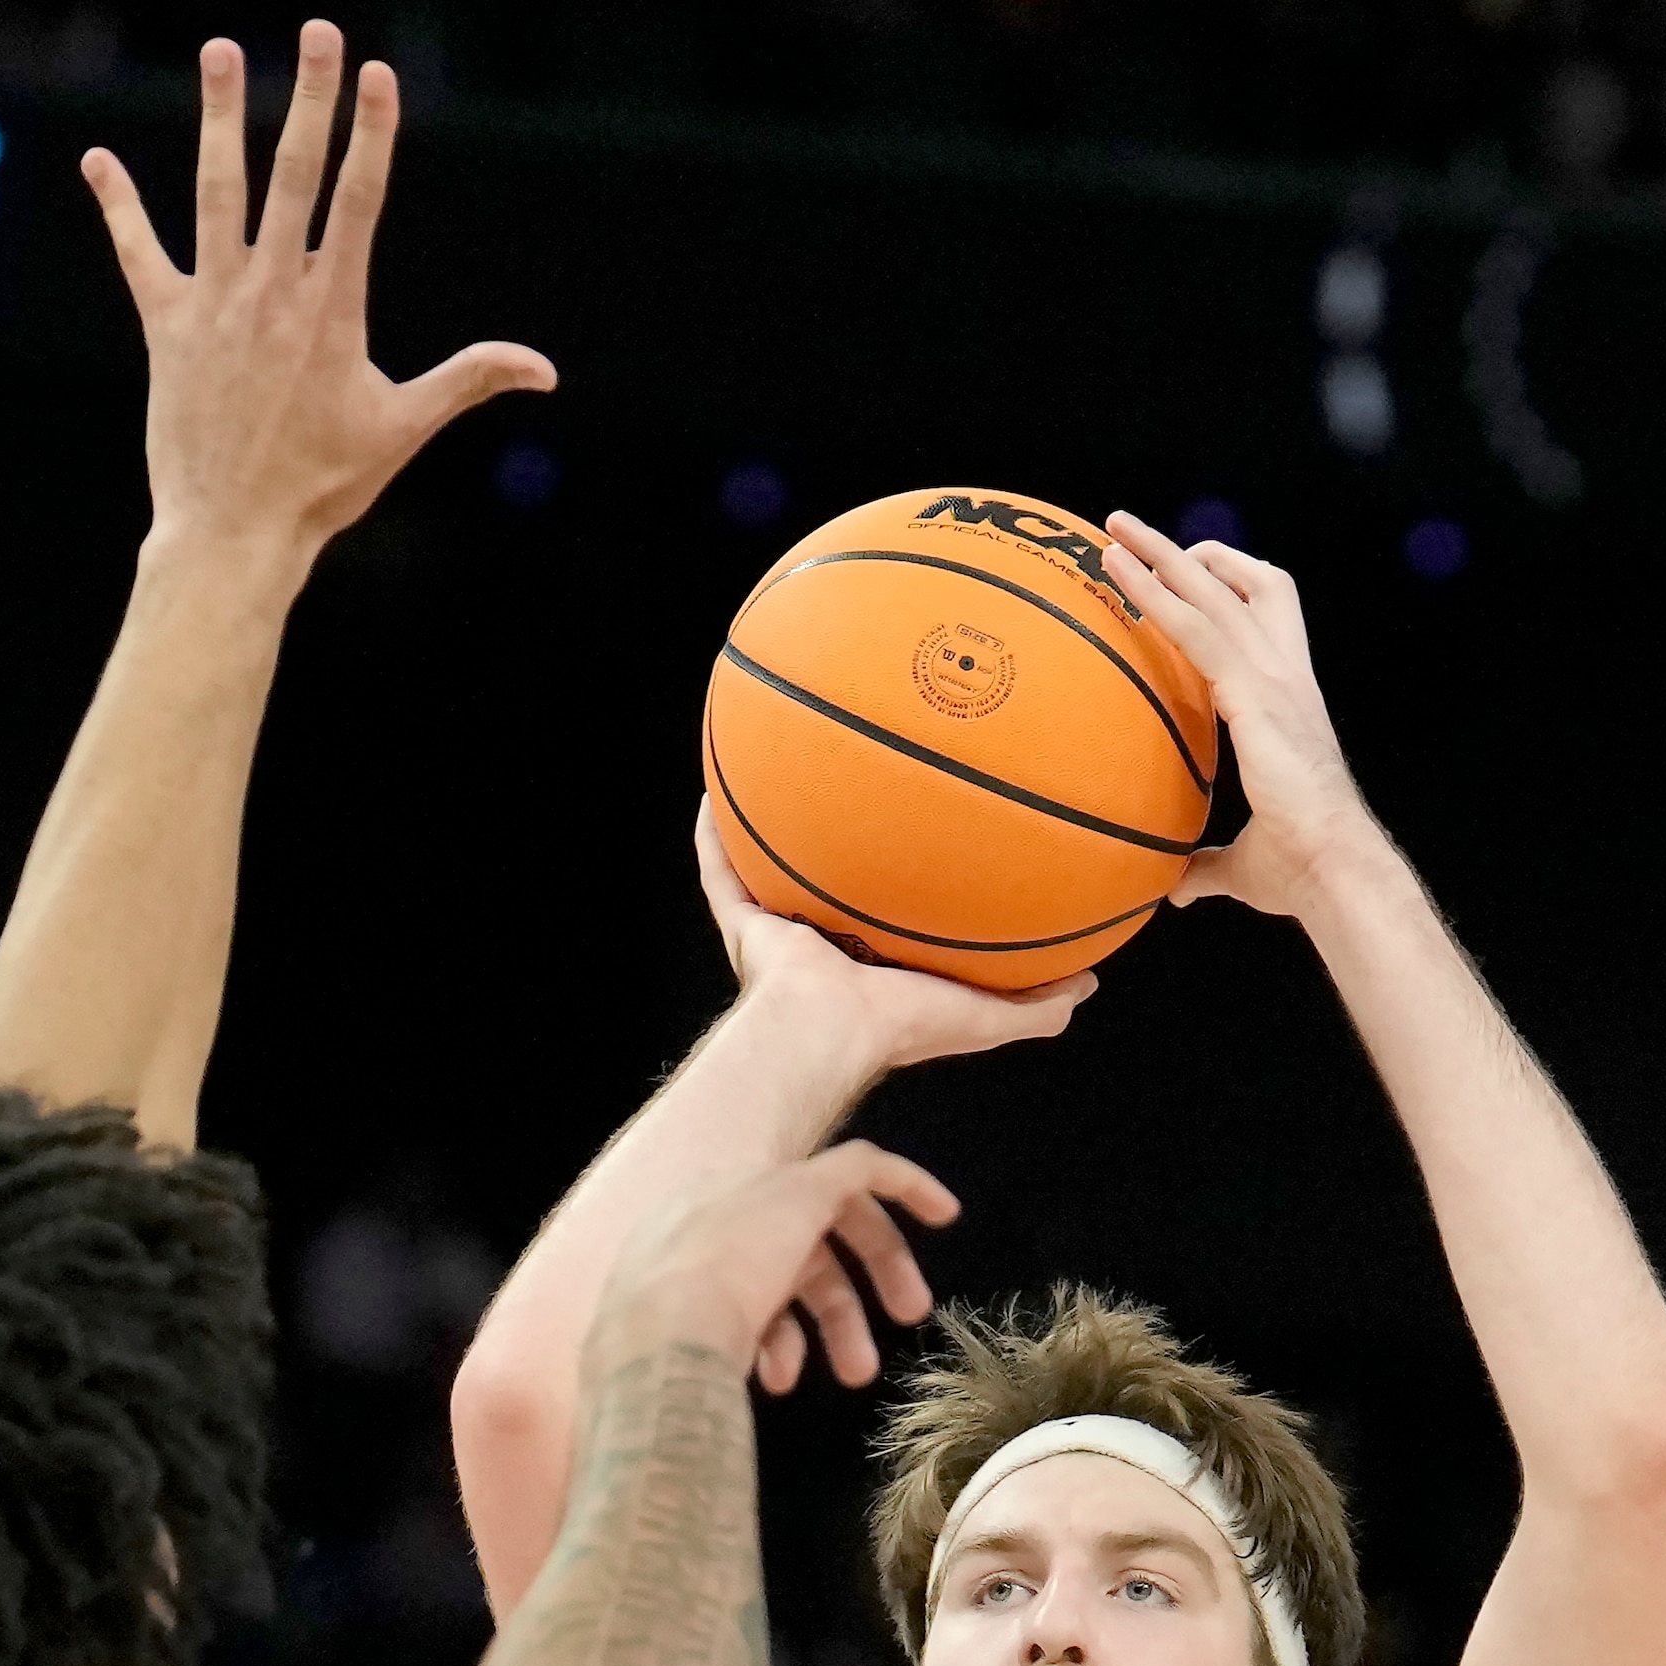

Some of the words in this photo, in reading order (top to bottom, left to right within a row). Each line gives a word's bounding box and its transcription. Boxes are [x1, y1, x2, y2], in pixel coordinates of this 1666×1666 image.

[907, 522, 1008, 545] OFFICIAL
[1015, 541, 1080, 581] GAME
[1082, 581, 1131, 632] BALL
[959, 627, 989, 644] SIZE
